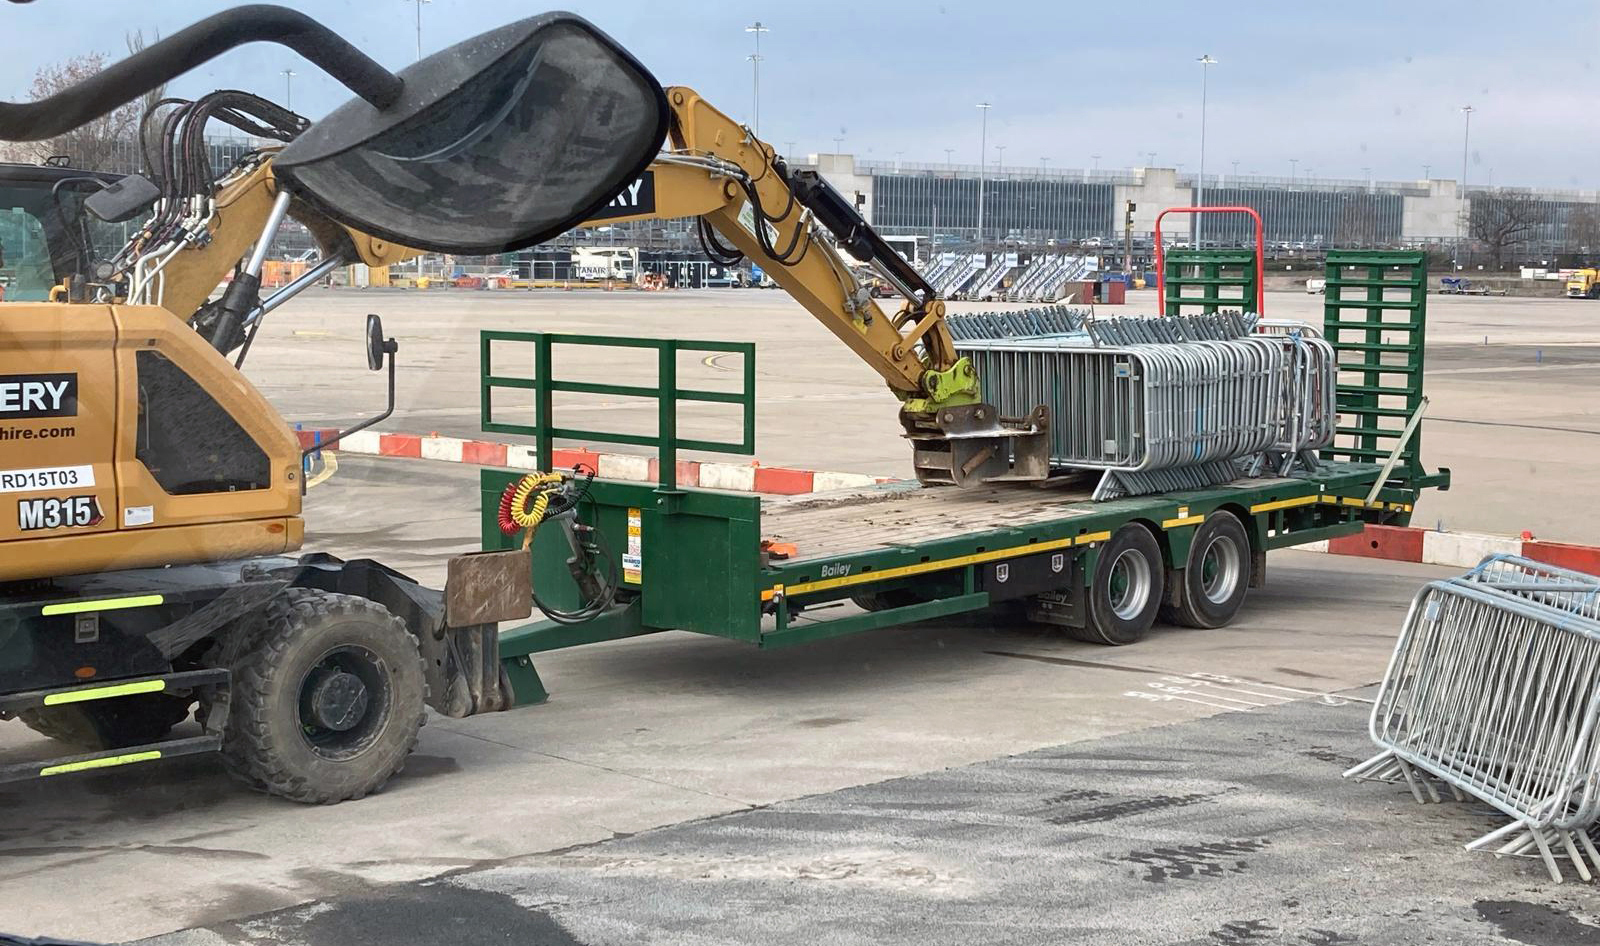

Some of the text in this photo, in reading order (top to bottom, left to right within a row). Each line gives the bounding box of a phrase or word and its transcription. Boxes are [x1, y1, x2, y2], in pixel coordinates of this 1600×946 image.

[576, 266, 606, 275] YANAIR
[952, 265, 974, 288] RYANAIR
[986, 264, 1007, 288] RYANAIR
[2, 470, 78, 488] RD15T03
[19, 497, 91, 530] M315
[821, 562, 851, 577] Bailey
